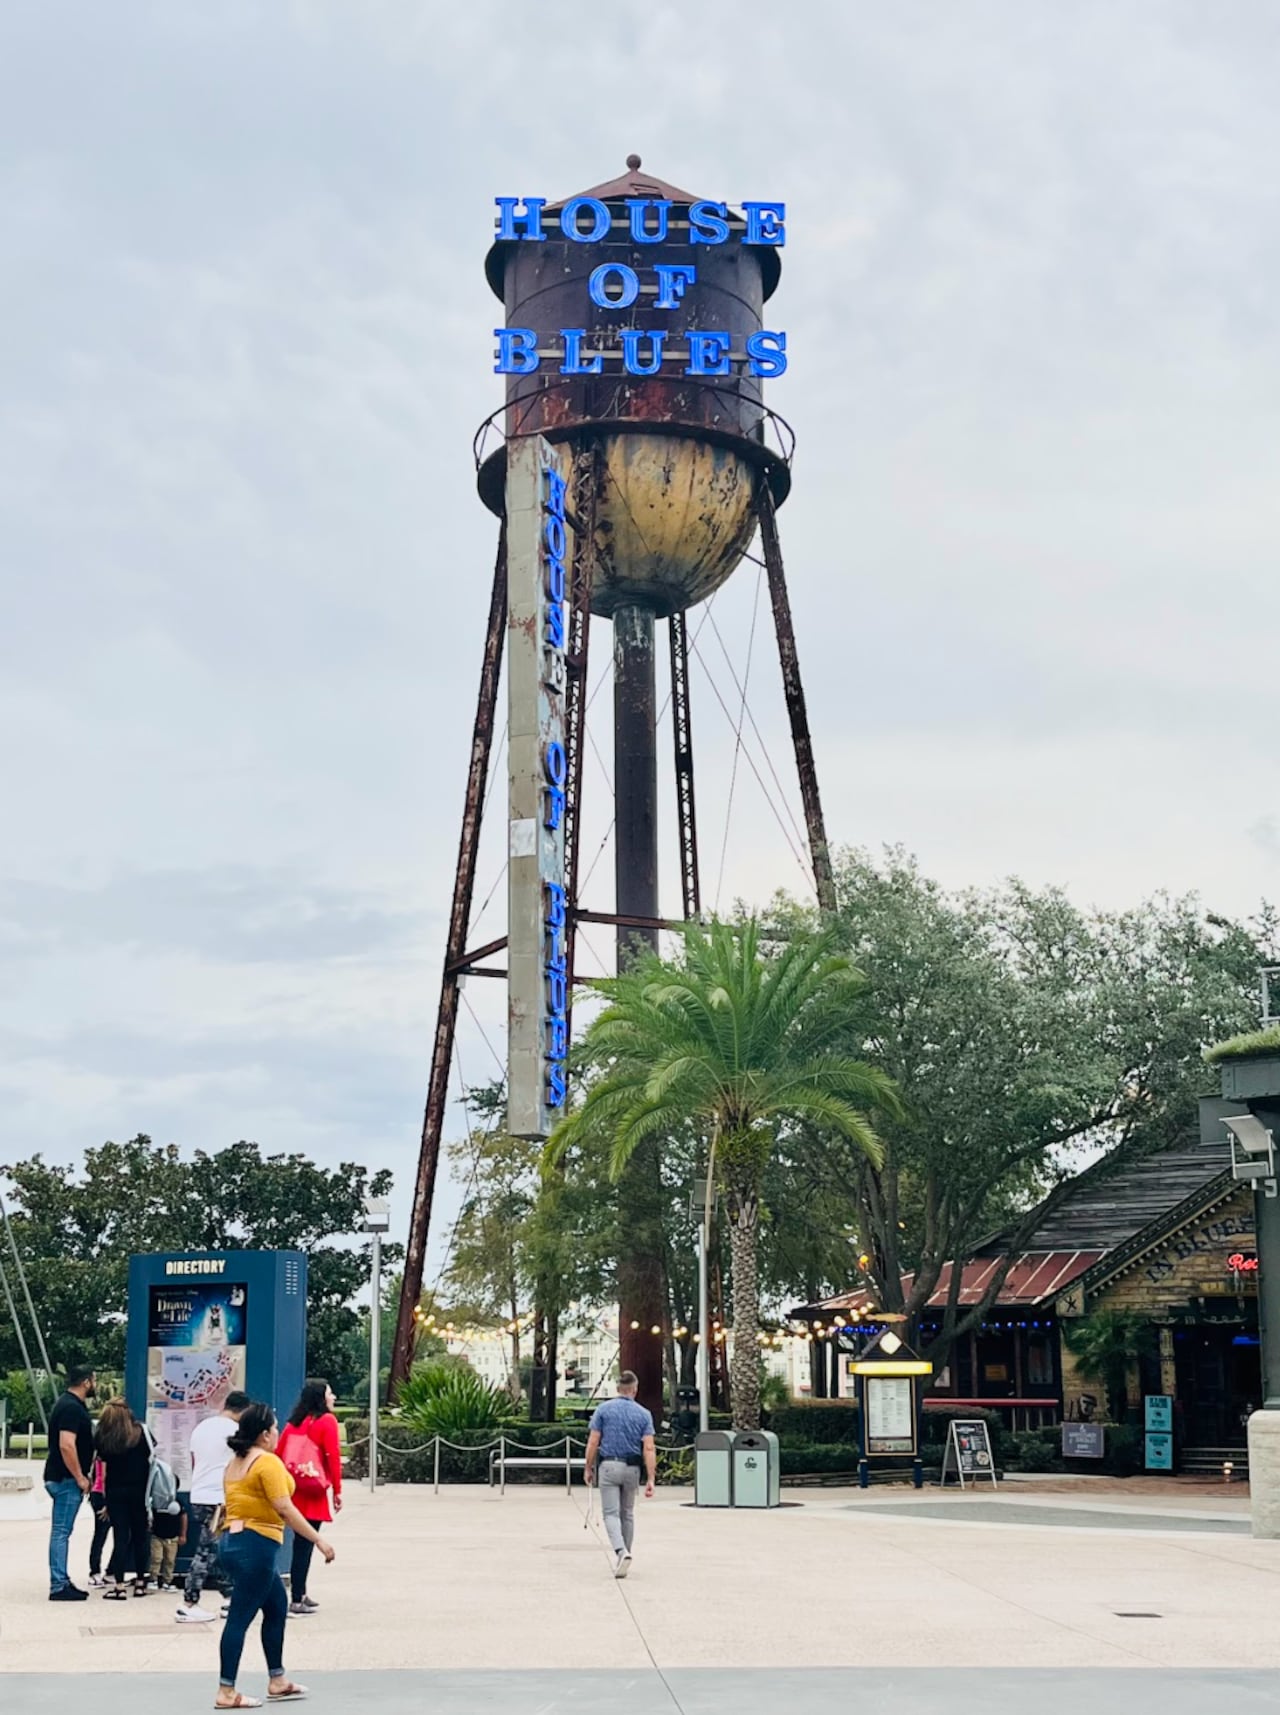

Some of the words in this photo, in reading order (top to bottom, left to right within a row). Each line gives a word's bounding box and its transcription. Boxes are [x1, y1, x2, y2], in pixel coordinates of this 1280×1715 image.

[494, 196, 787, 247] HOUSE
[587, 262, 698, 311] OF
[493, 327, 788, 378] BLUES
[543, 466, 567, 692] HOUSE
[544, 741, 567, 830] OF
[544, 881, 568, 1108] BLUES
[166, 1259, 226, 1275] DIRECTORY
